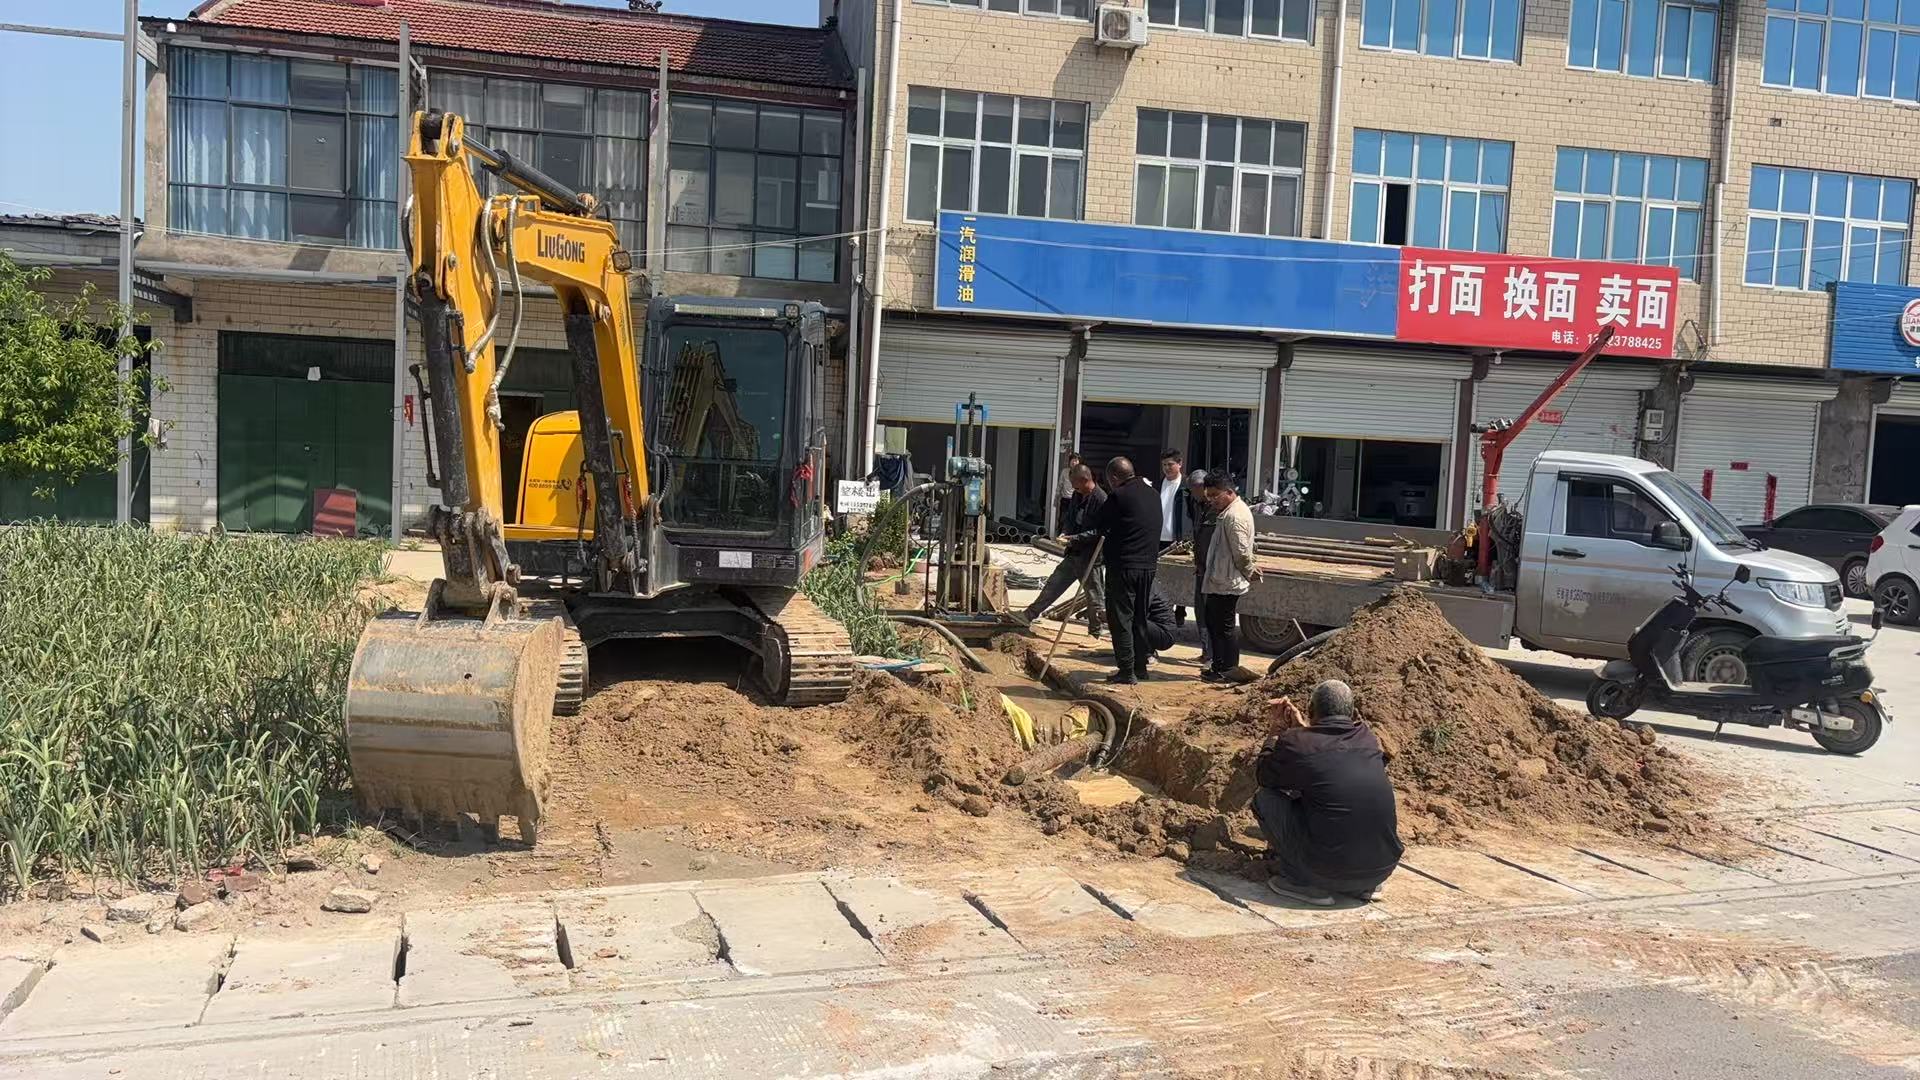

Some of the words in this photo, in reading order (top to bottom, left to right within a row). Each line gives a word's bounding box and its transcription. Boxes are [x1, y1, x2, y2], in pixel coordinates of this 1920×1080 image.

[957, 217, 977, 303] 一汽润滑油
[1408, 259, 1486, 317] 打面
[1503, 266, 1580, 323] 换面
[1595, 273, 1673, 330] 卖面
[1587, 333, 1663, 350] 123788425
